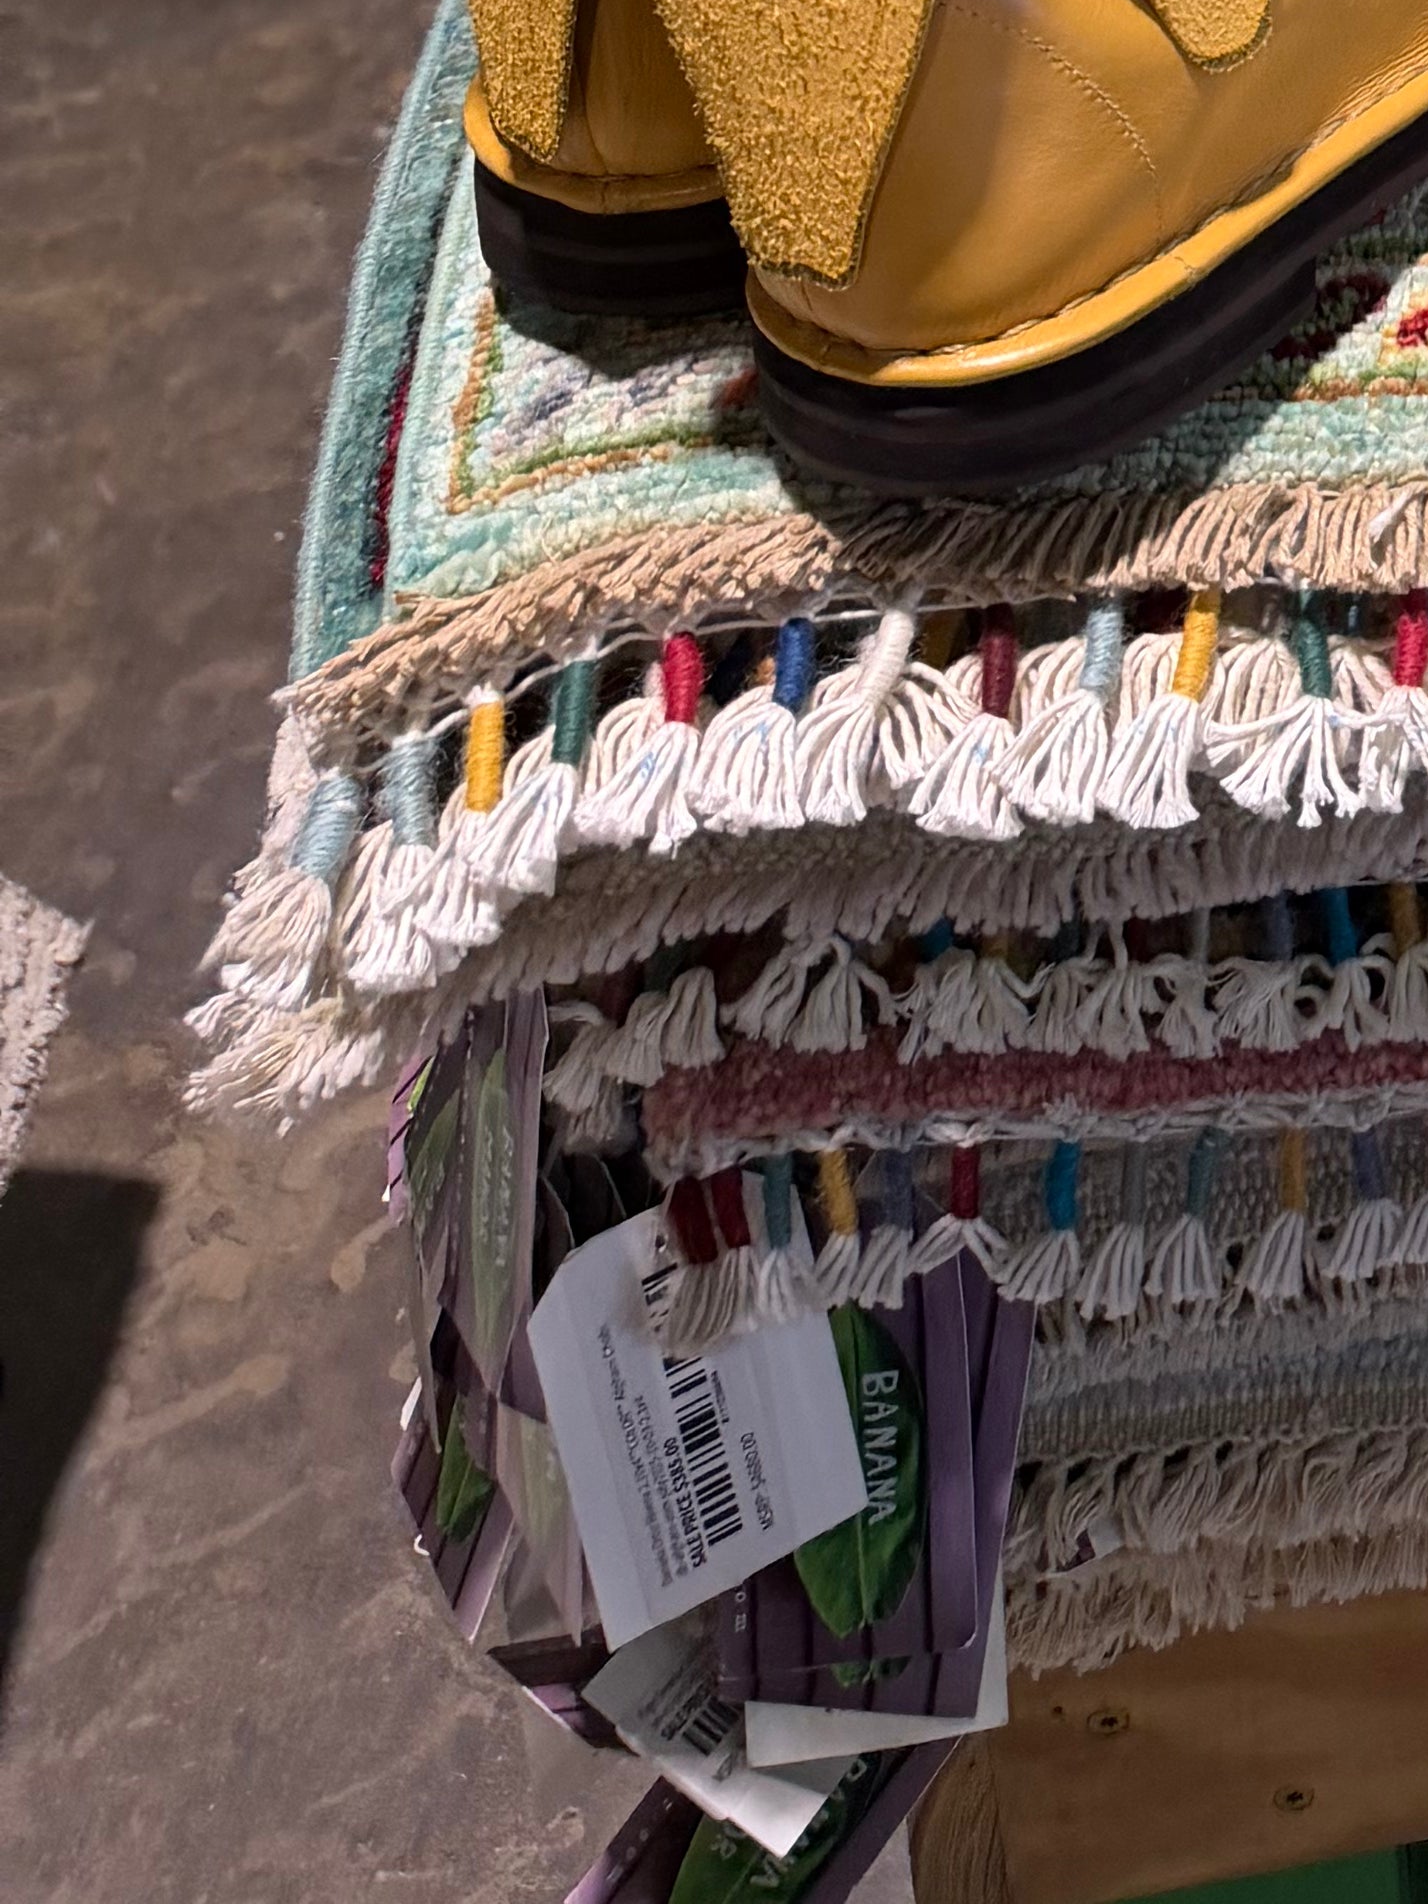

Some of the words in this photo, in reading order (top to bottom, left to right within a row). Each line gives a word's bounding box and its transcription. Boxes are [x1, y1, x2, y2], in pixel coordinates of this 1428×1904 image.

[662, 1436, 690, 1494] $385.00
[860, 1369, 898, 1525] BANANA
[675, 1491, 699, 1535] PRICE
[685, 1534, 706, 1568] SALE
